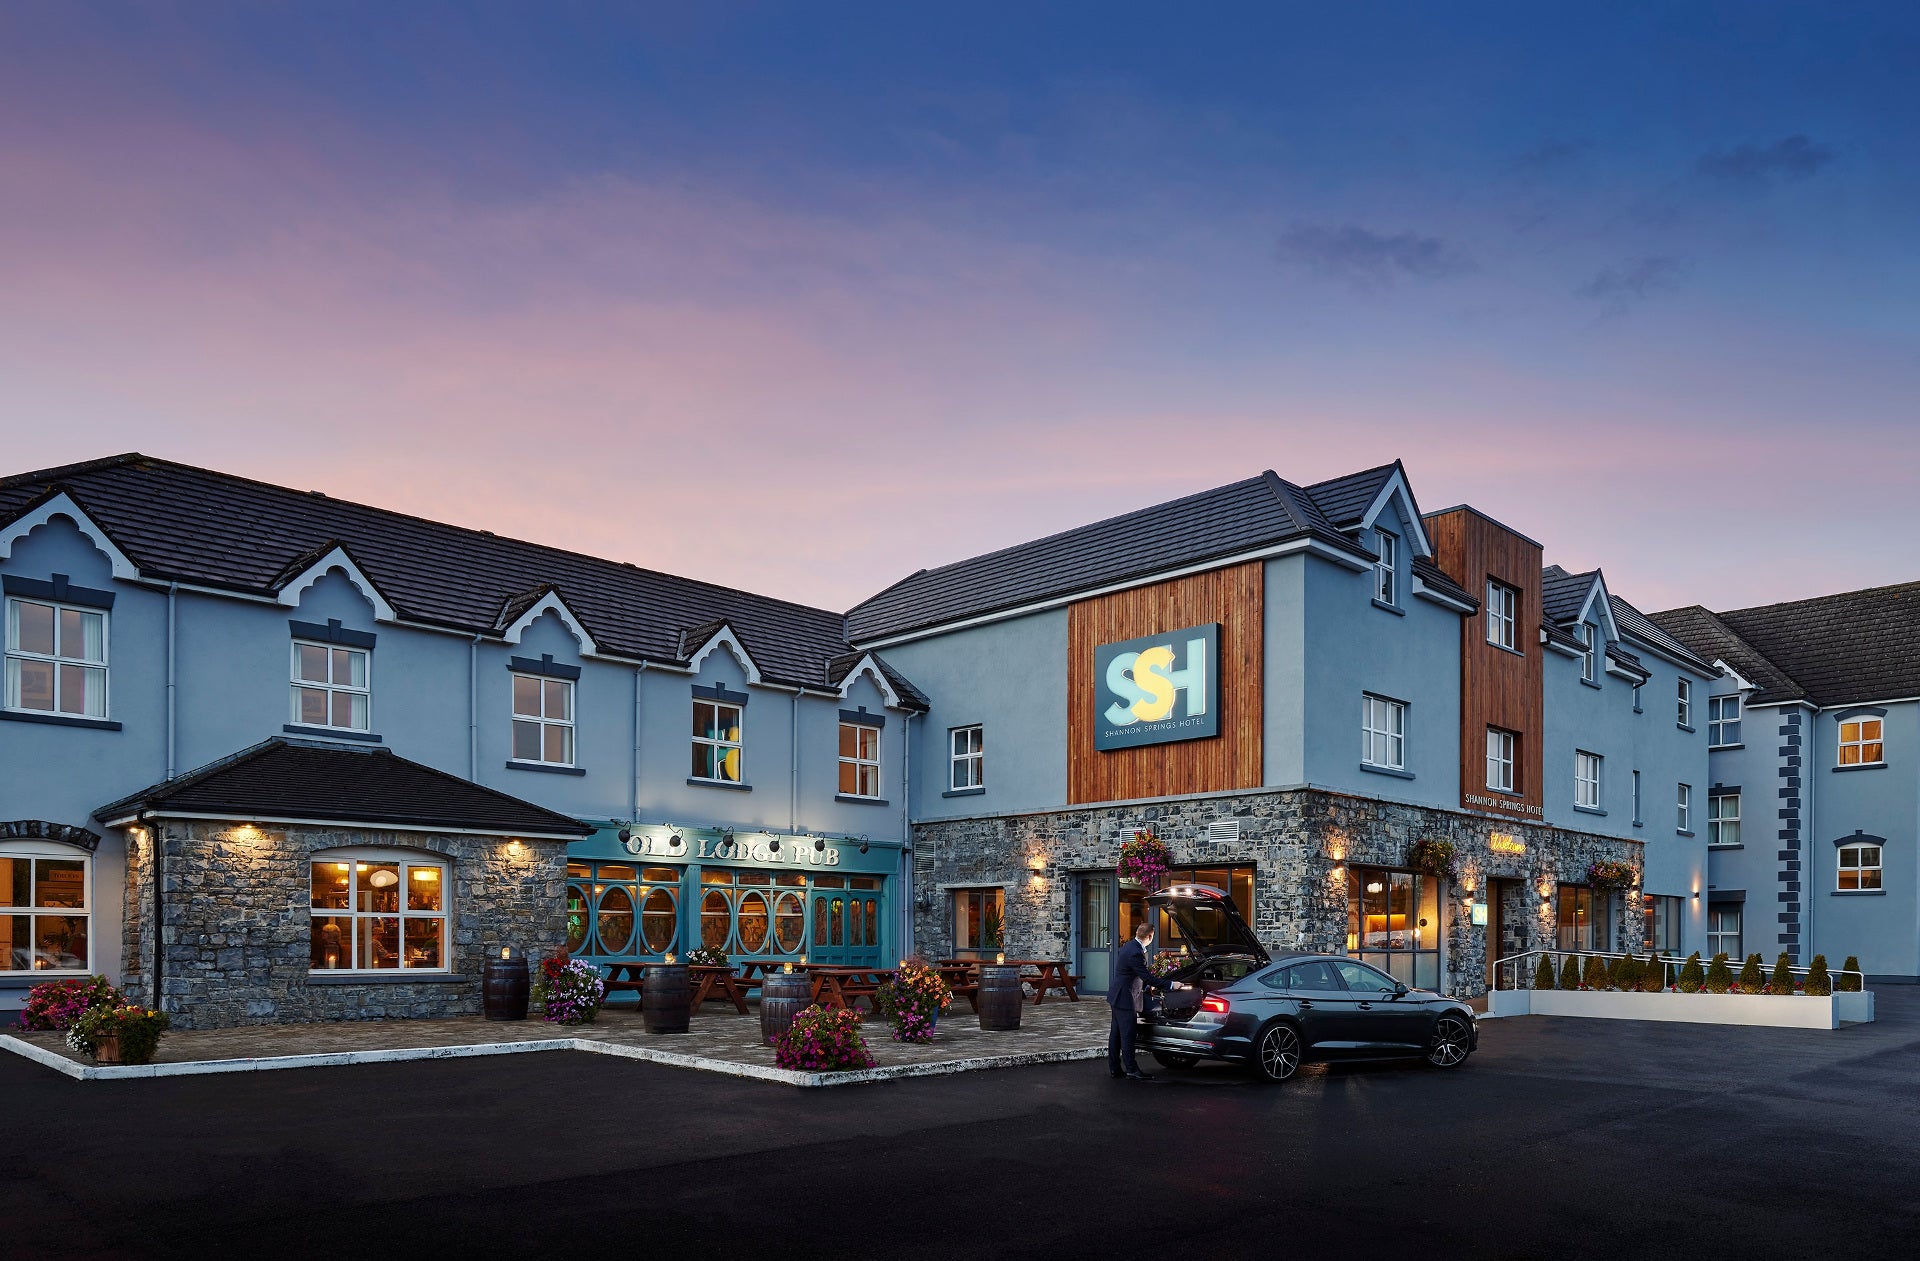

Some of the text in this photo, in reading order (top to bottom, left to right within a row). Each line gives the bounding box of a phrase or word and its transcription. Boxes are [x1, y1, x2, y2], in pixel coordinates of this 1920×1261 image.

[1103, 637, 1206, 727] SSH
[1105, 717, 1205, 738] SHANNON SPRINGS HOTEL
[1465, 793, 1497, 807] SHANNON
[1499, 799, 1525, 813] SPRINGS
[626, 835, 839, 866] OLD LODGE PUB
